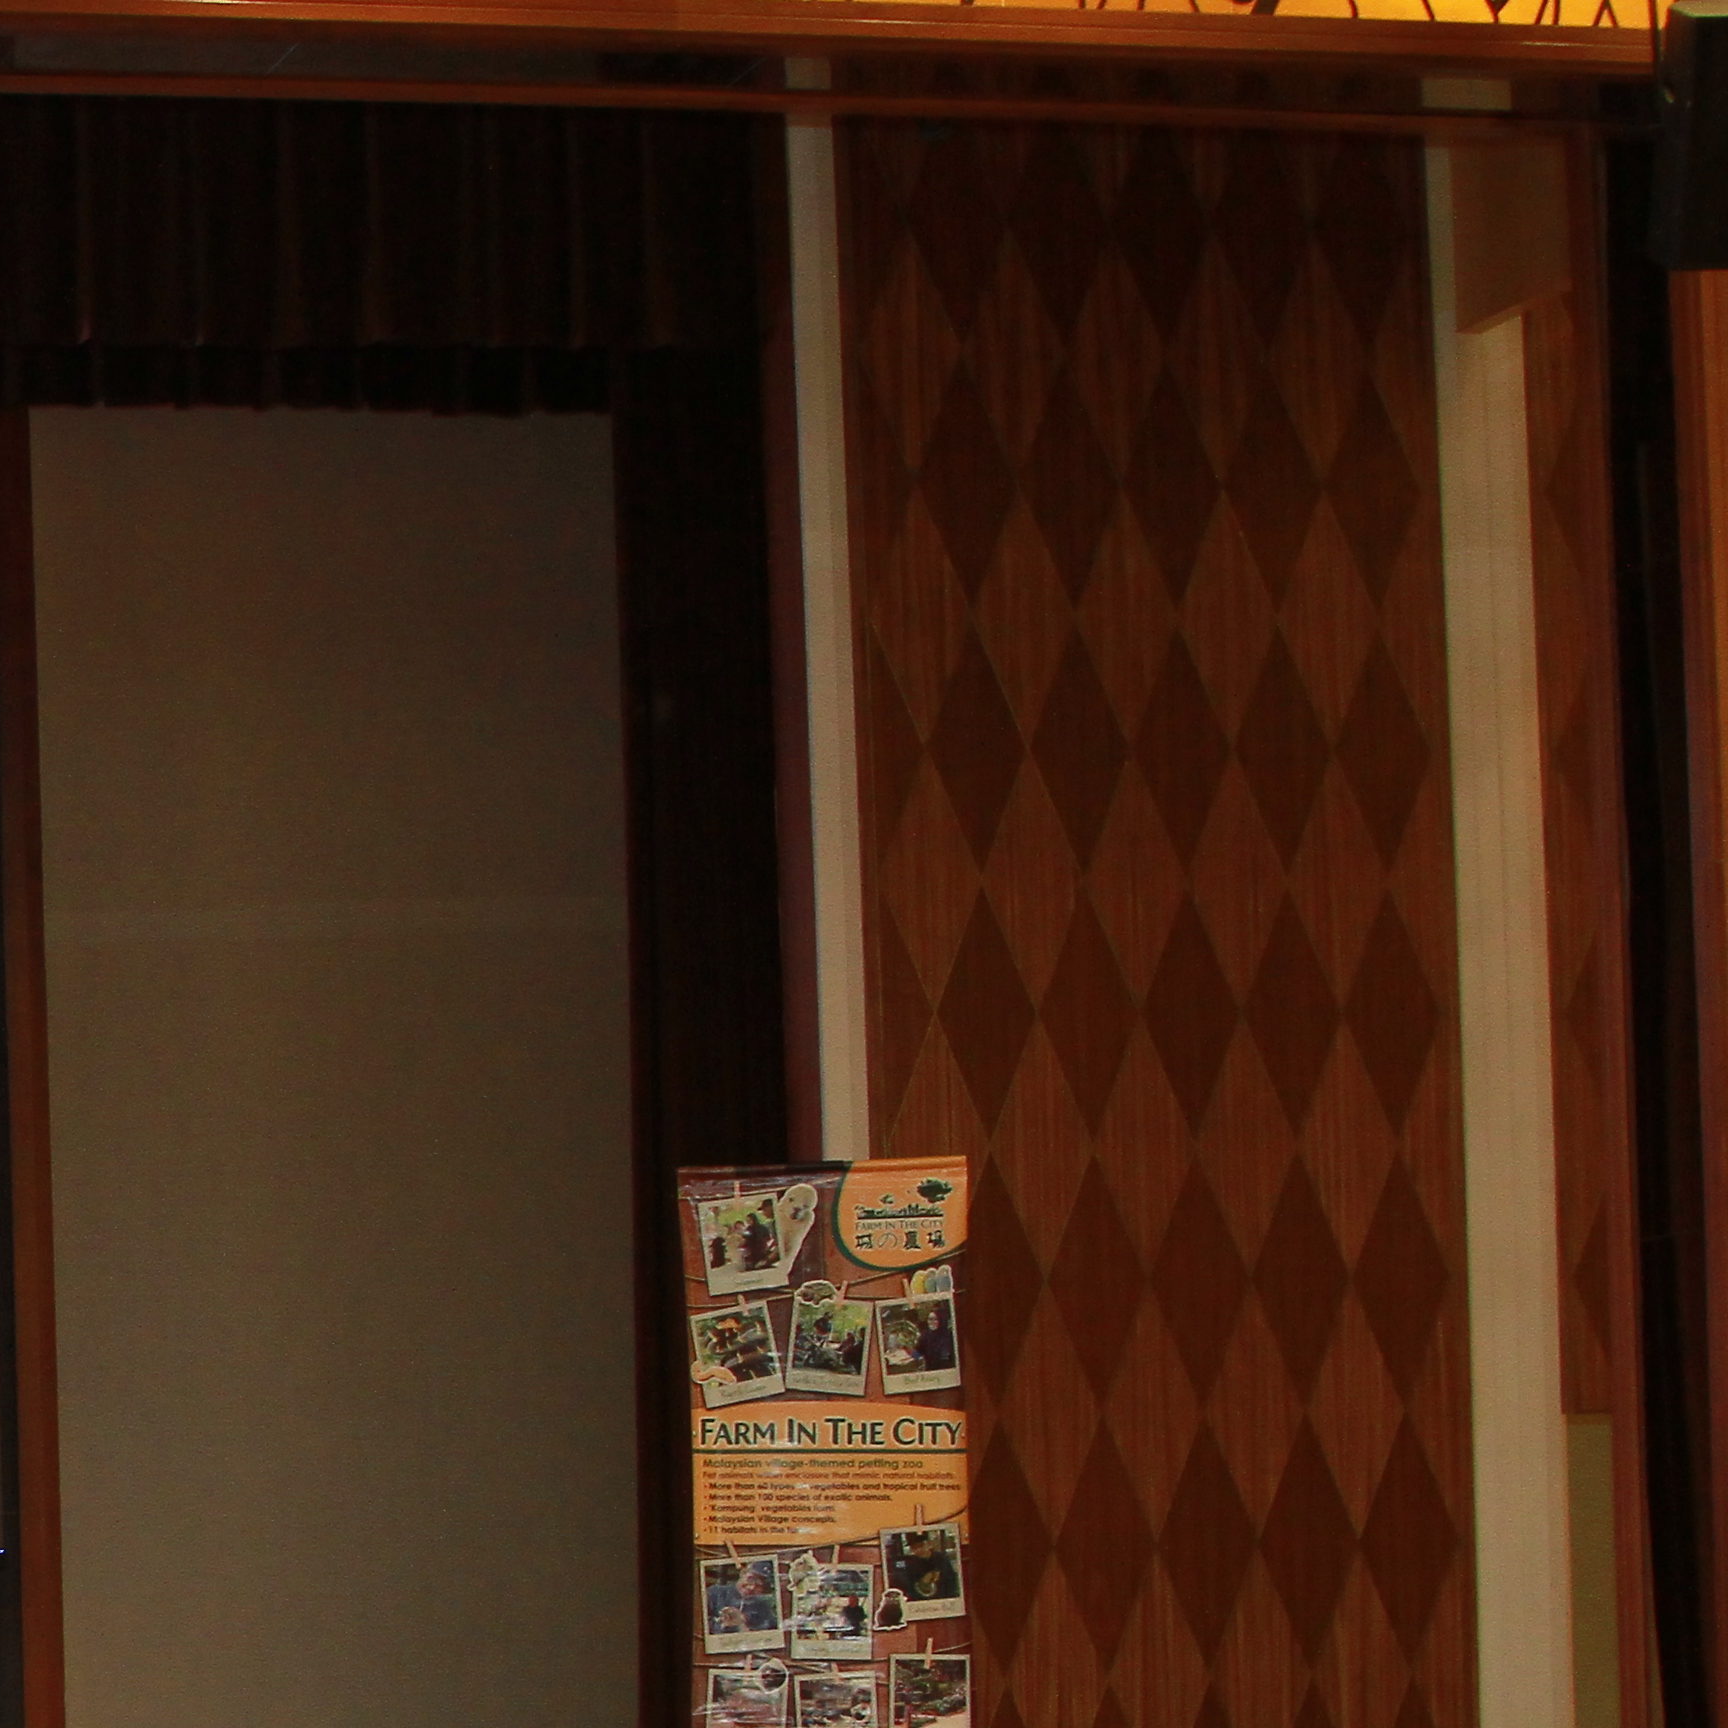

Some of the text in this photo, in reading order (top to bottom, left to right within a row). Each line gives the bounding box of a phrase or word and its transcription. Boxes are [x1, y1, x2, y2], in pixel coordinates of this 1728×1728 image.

[700, 1418, 961, 1445] FARM IN THE CITY
[764, 1459, 854, 1470] vage-themed
